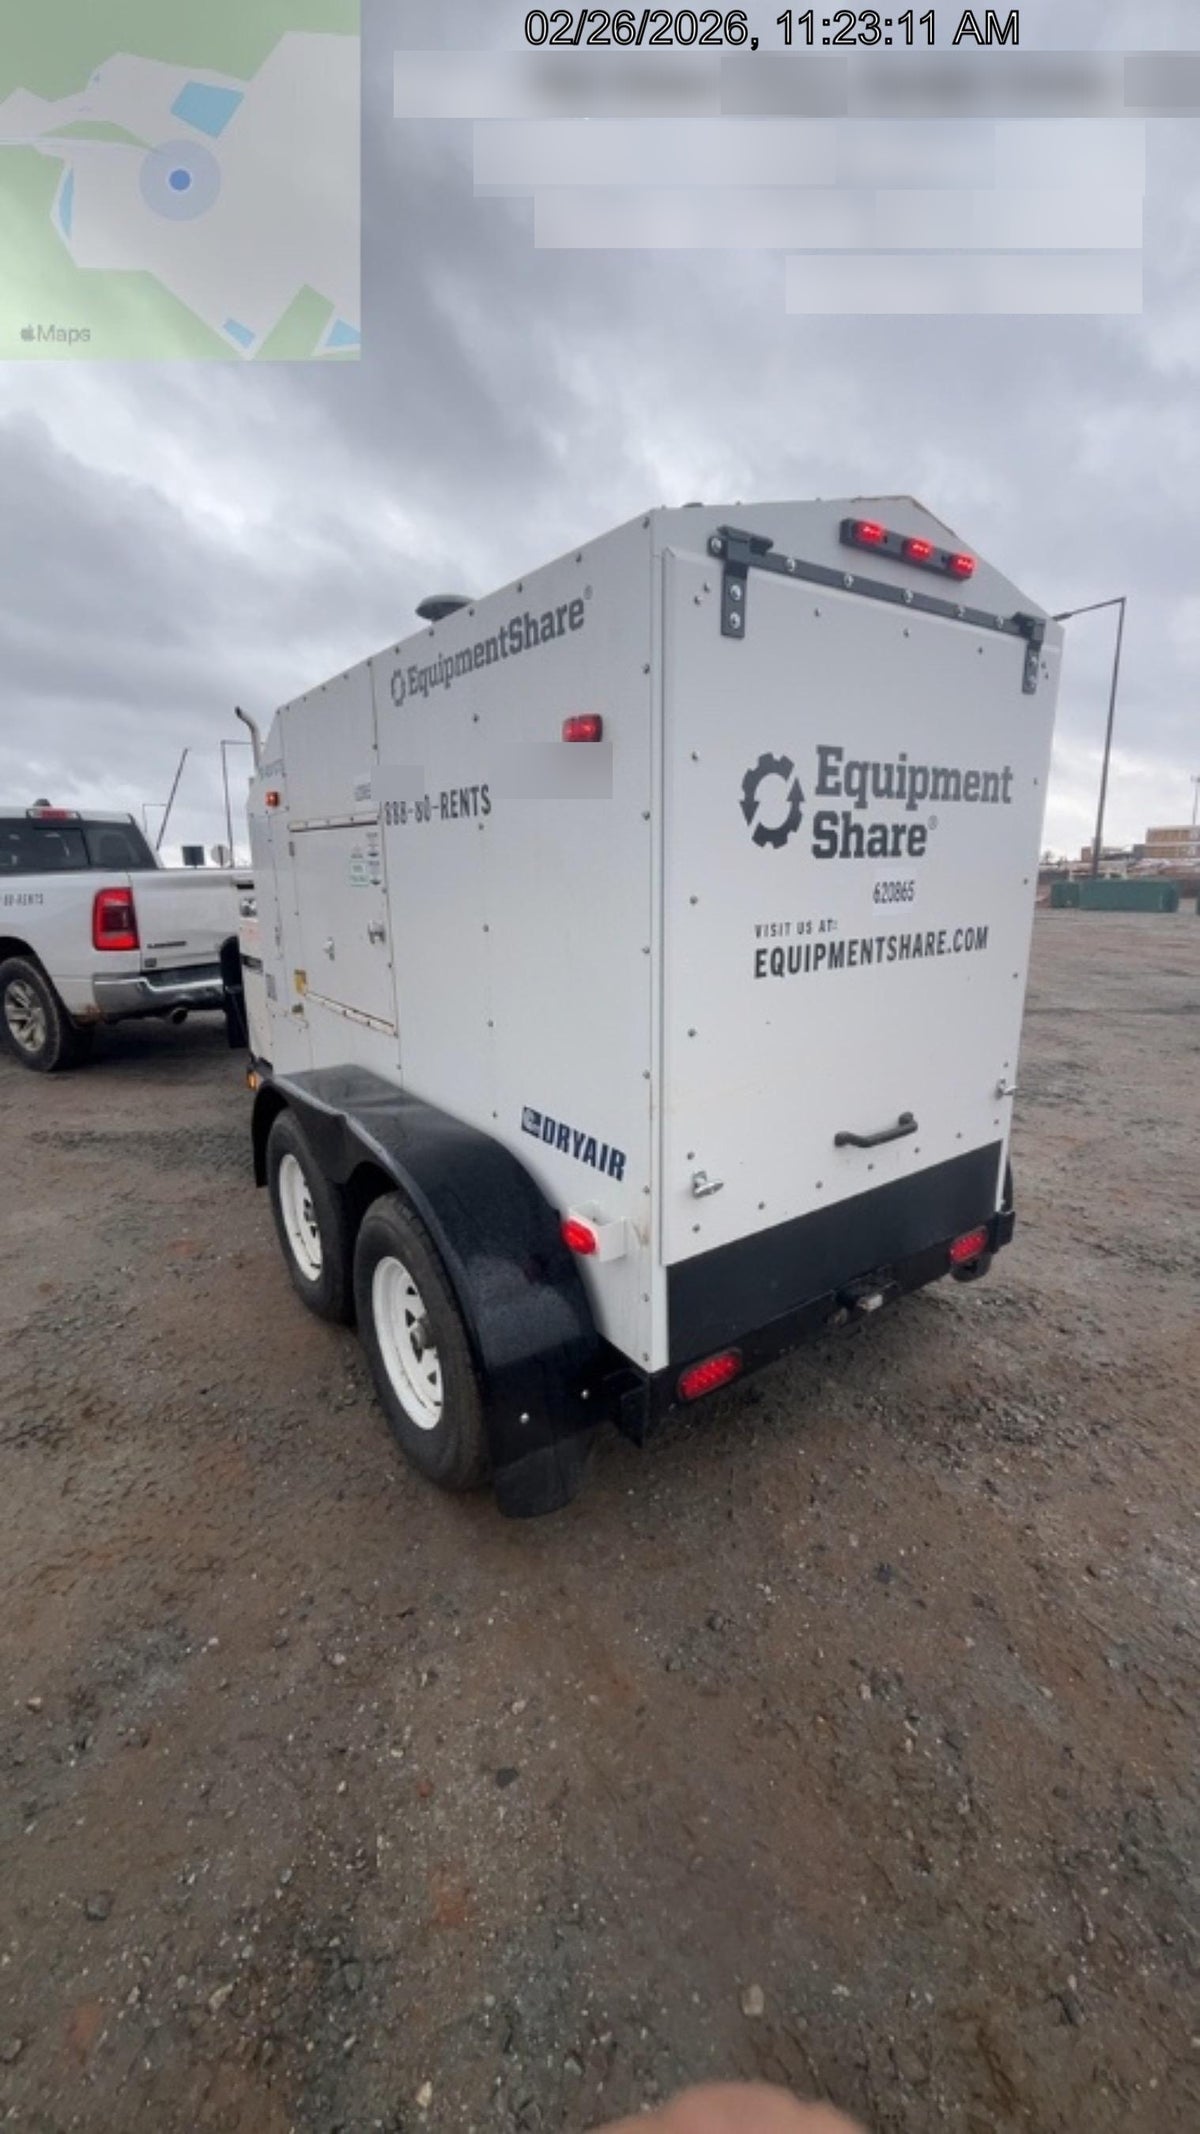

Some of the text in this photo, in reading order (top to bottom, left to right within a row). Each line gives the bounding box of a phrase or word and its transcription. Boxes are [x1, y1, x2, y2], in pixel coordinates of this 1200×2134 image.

[815, 744, 1014, 811] Equipment
[755, 922, 791, 938] VISIT
[797, 920, 813, 935] US
[755, 925, 990, 979] EQUIPMENTSHARE.COM
[542, 1116, 627, 1181] DRYAIR
